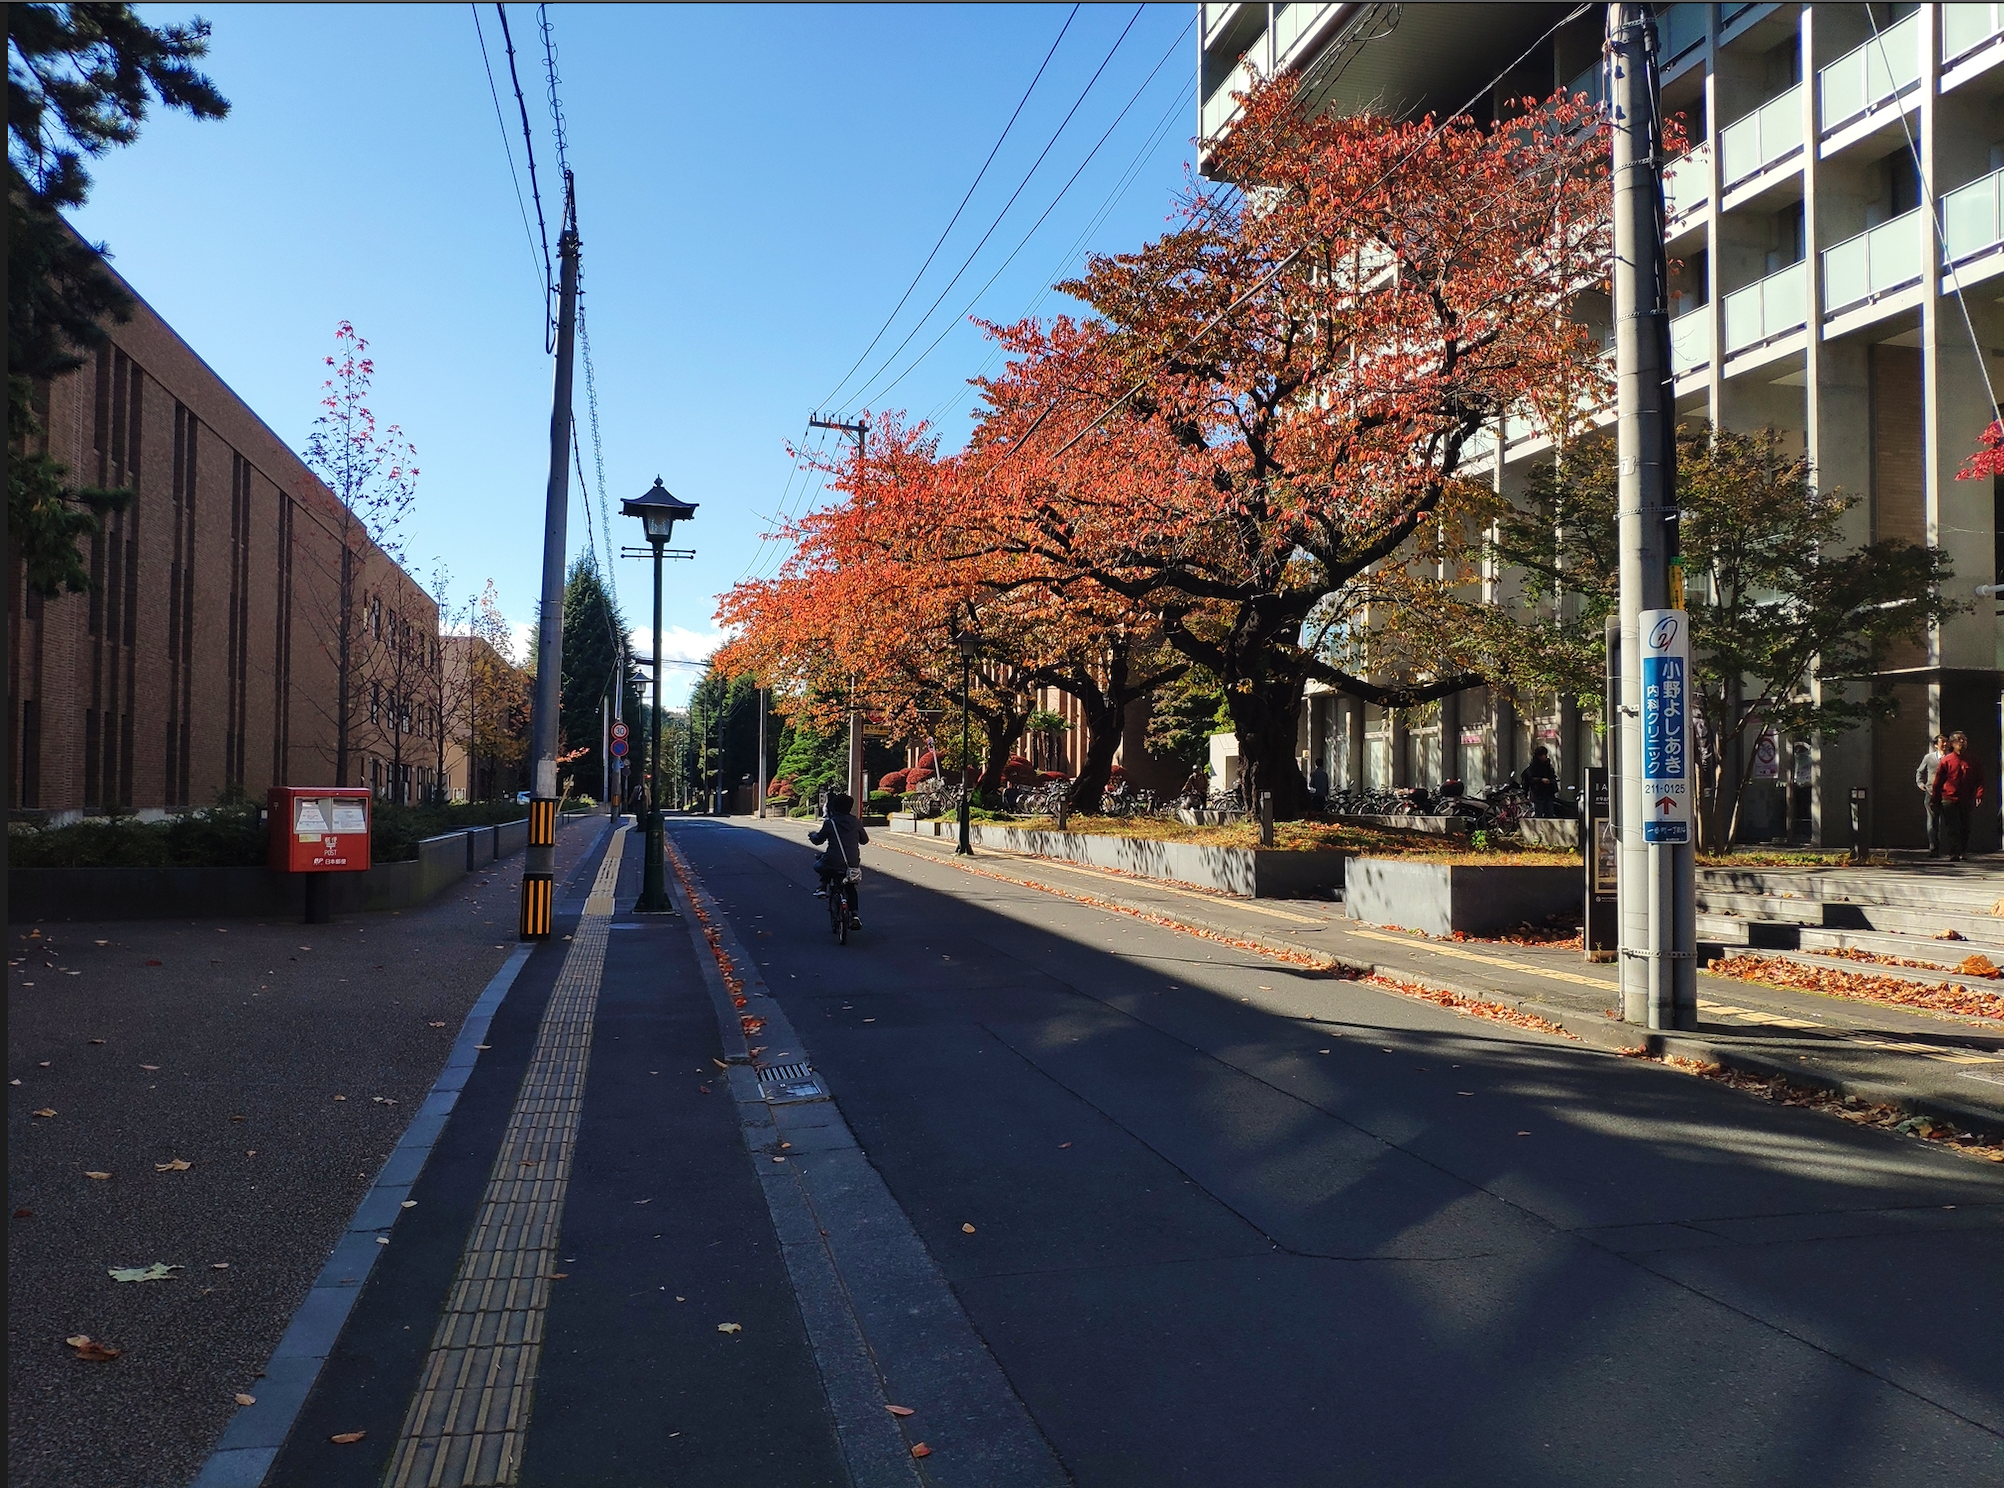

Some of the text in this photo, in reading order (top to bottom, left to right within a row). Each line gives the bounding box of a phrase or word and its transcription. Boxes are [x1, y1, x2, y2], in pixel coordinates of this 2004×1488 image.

[615, 727, 624, 735] 30
[1646, 684, 1661, 775] 内科クリニック
[1662, 661, 1682, 774] 小野よしあき
[1645, 783, 1686, 794] 211-0125
